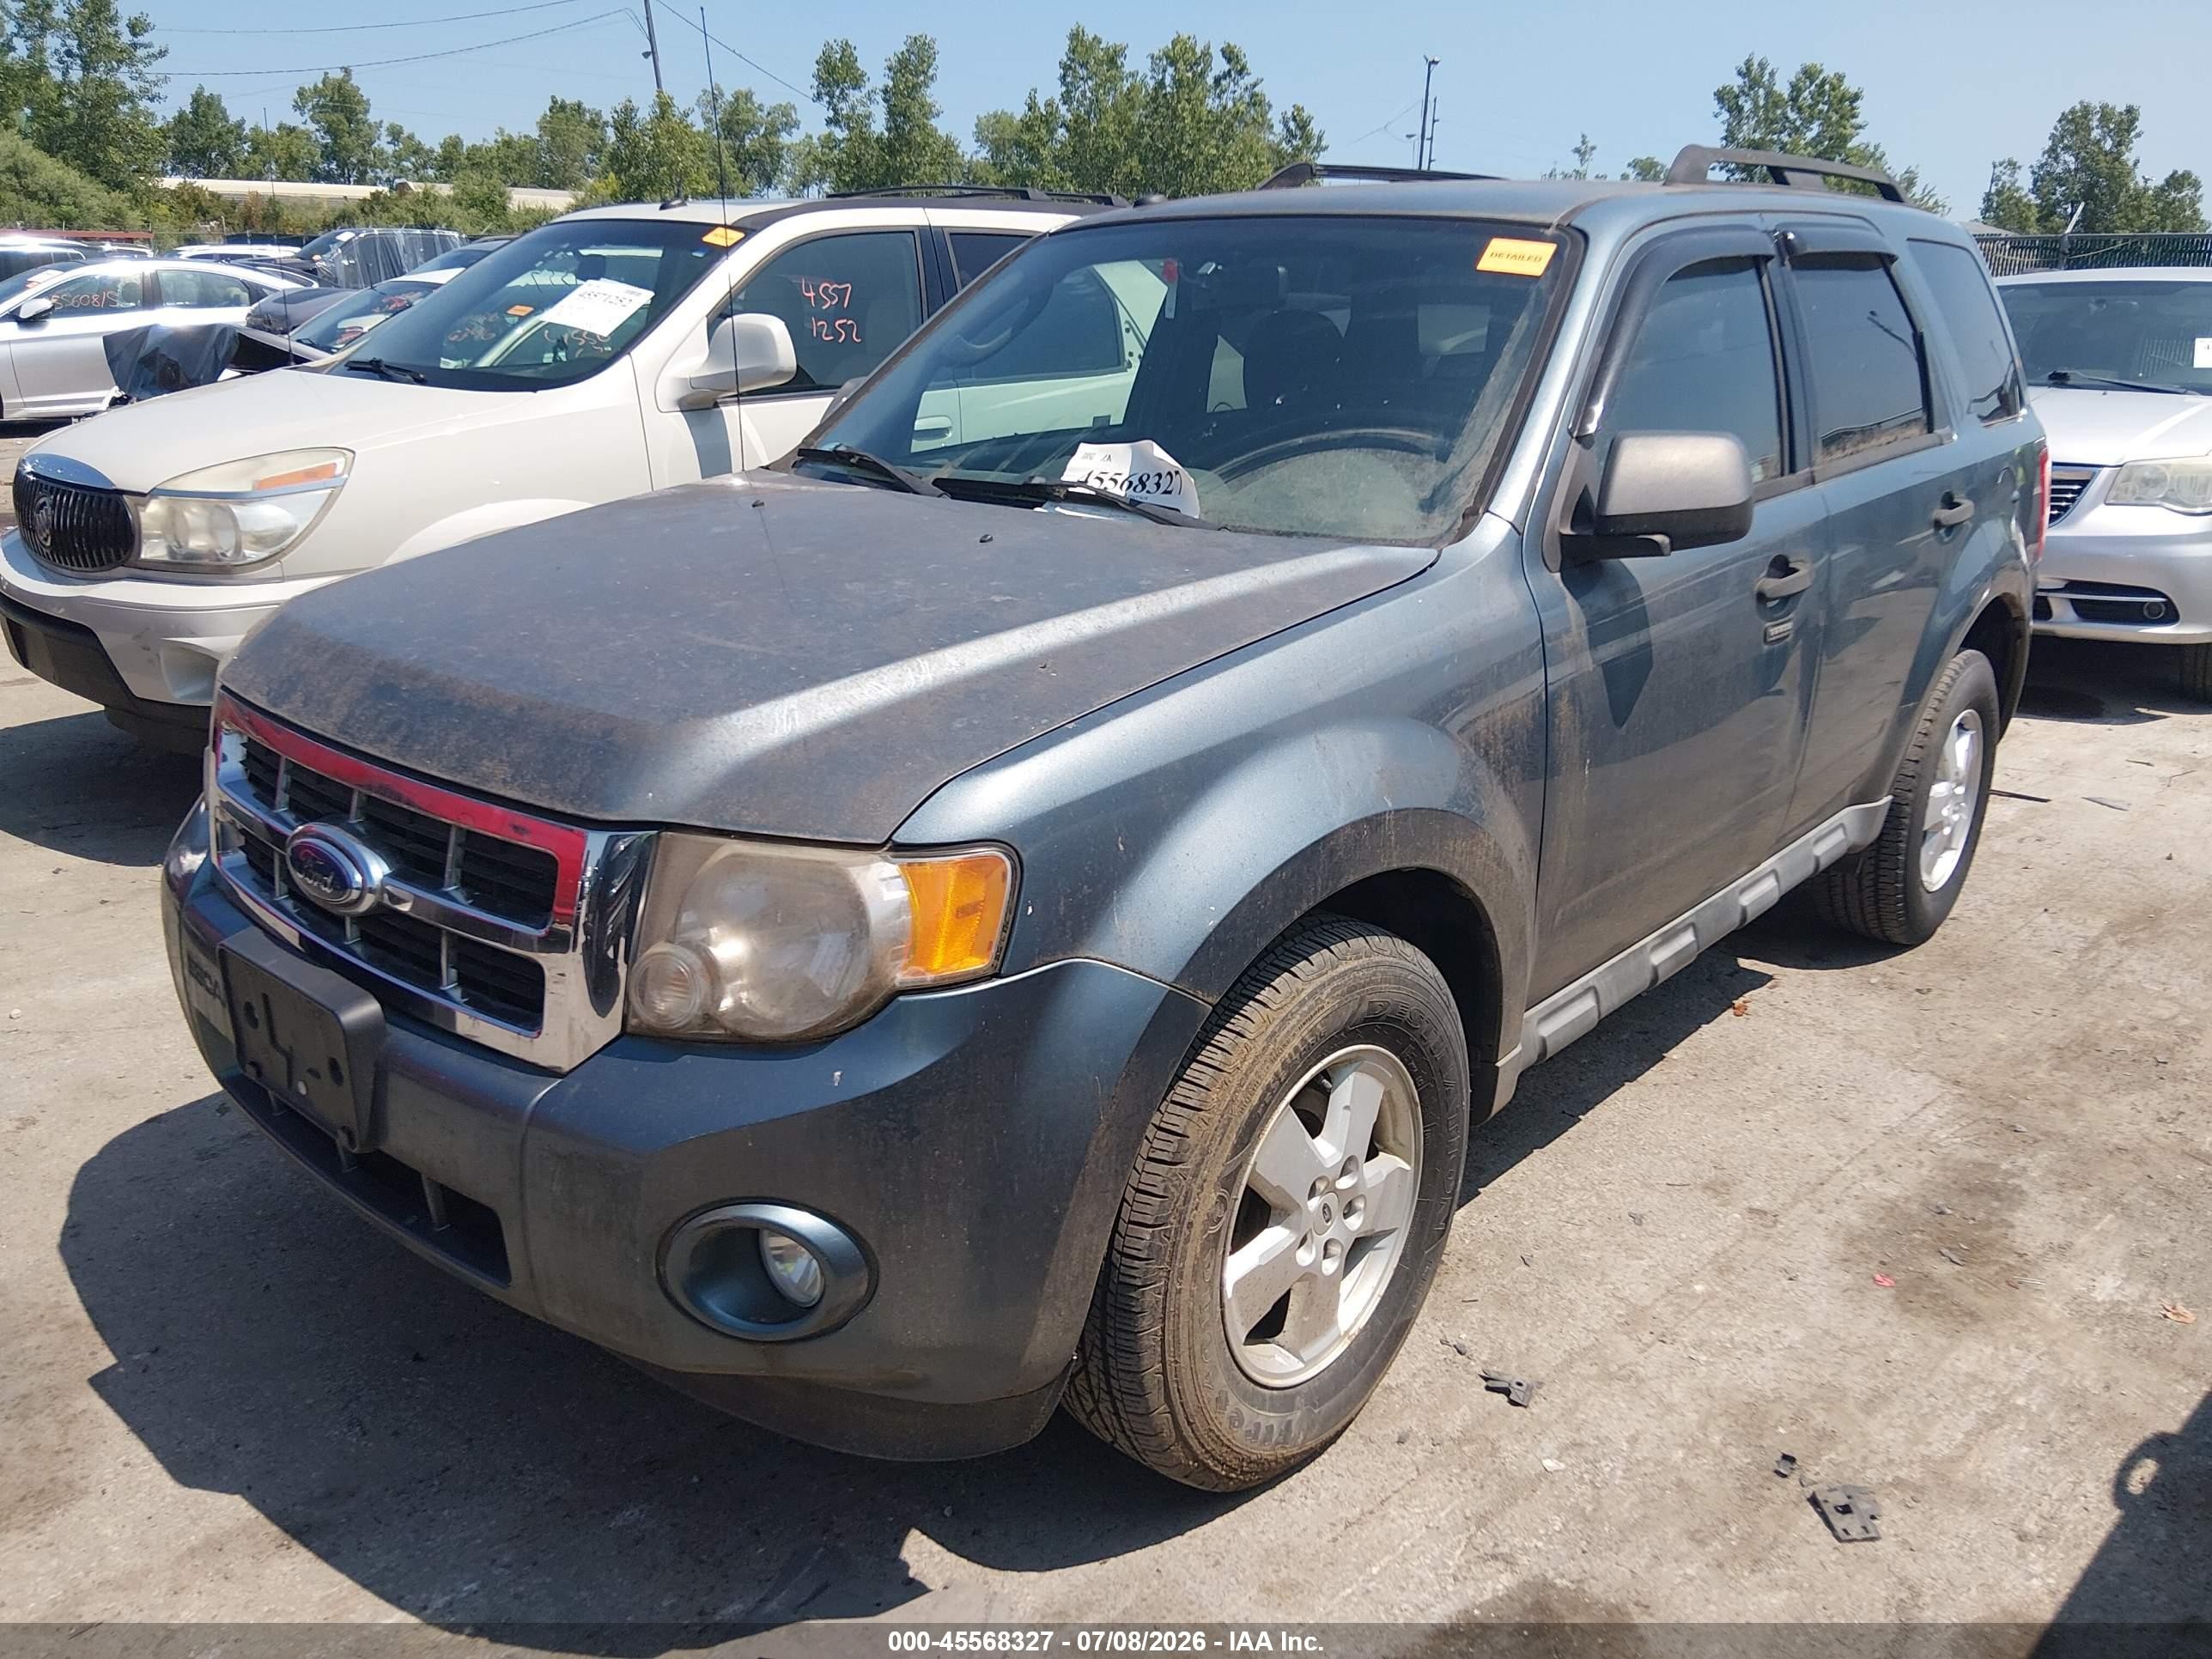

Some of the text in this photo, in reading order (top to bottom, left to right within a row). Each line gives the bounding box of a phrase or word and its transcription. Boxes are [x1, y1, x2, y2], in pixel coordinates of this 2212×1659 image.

[1489, 251, 1544, 264] DETAILED
[800, 276, 853, 310] 4557
[811, 315, 863, 344] 1252
[295, 848, 337, 895] Ford
